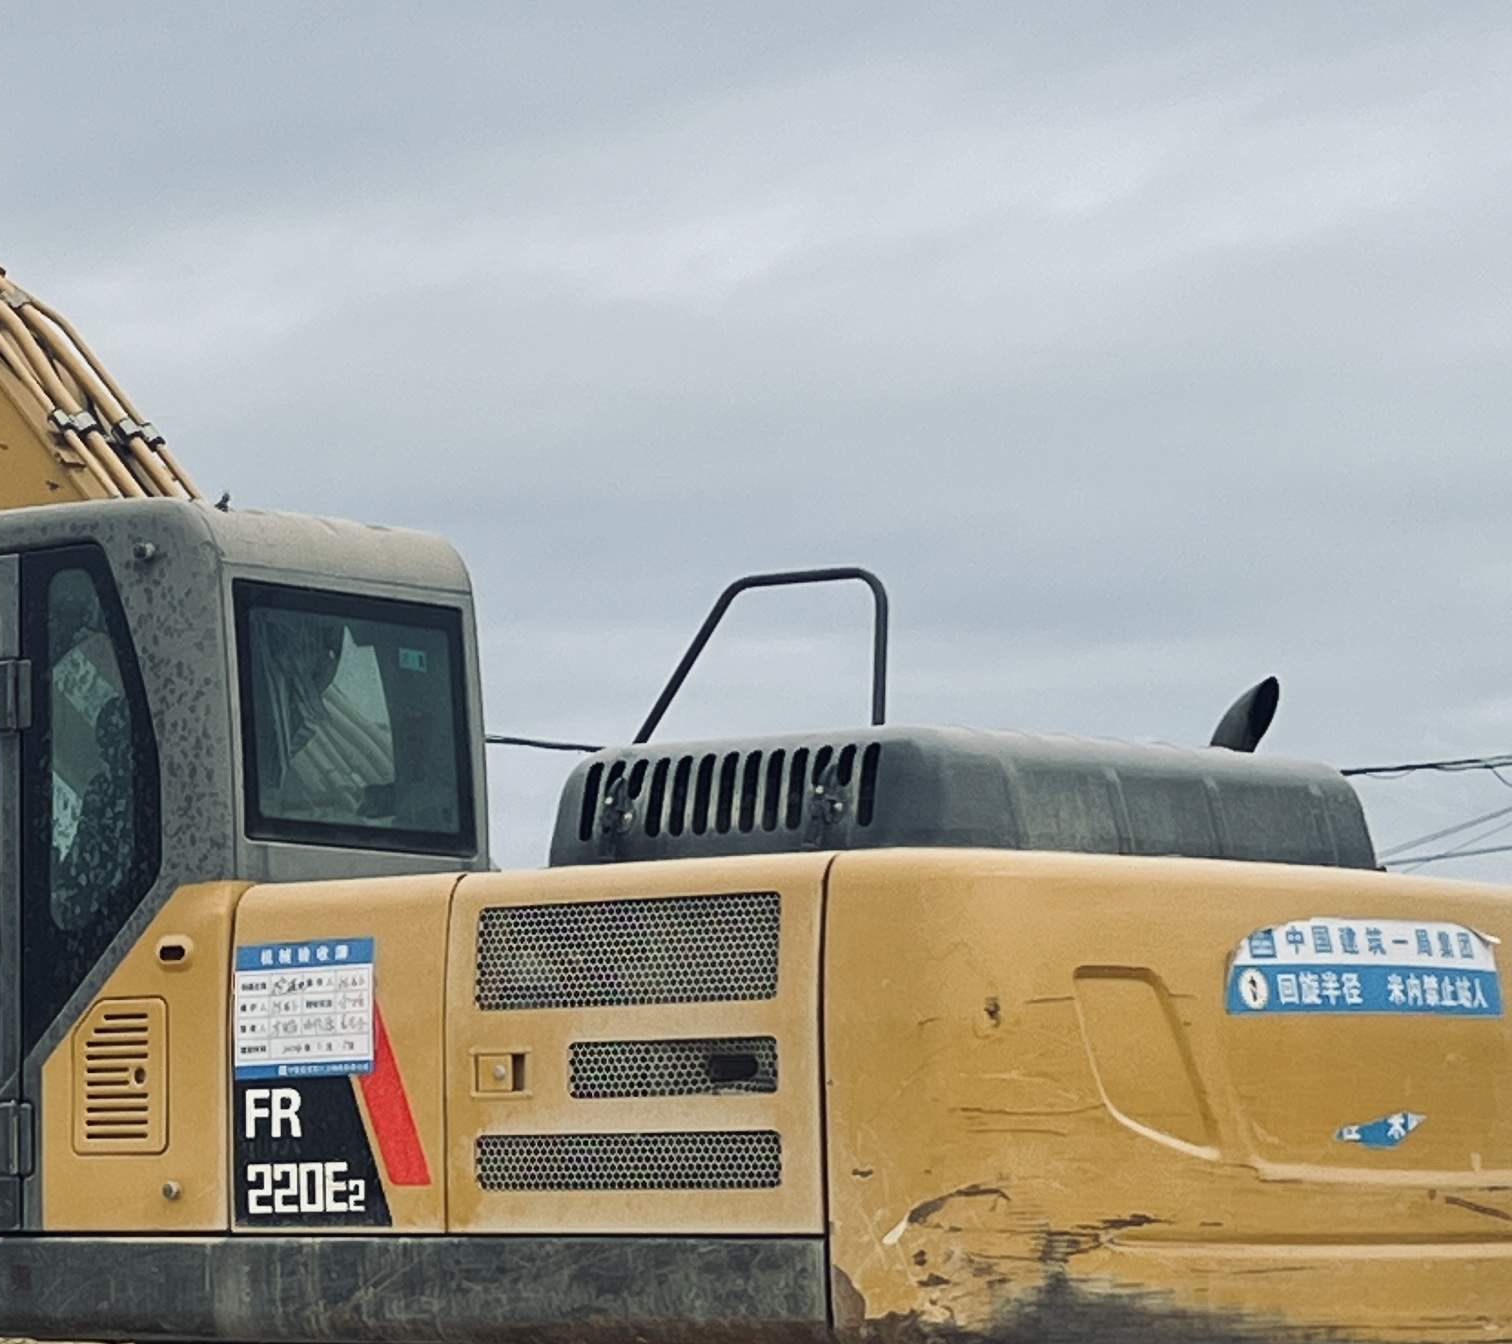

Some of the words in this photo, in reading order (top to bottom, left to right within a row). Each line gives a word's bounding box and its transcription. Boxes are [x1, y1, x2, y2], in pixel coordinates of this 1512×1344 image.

[1276, 971, 1363, 1006] 回旋半径
[245, 1087, 303, 1138] FR
[246, 1161, 366, 1215] 220E2
